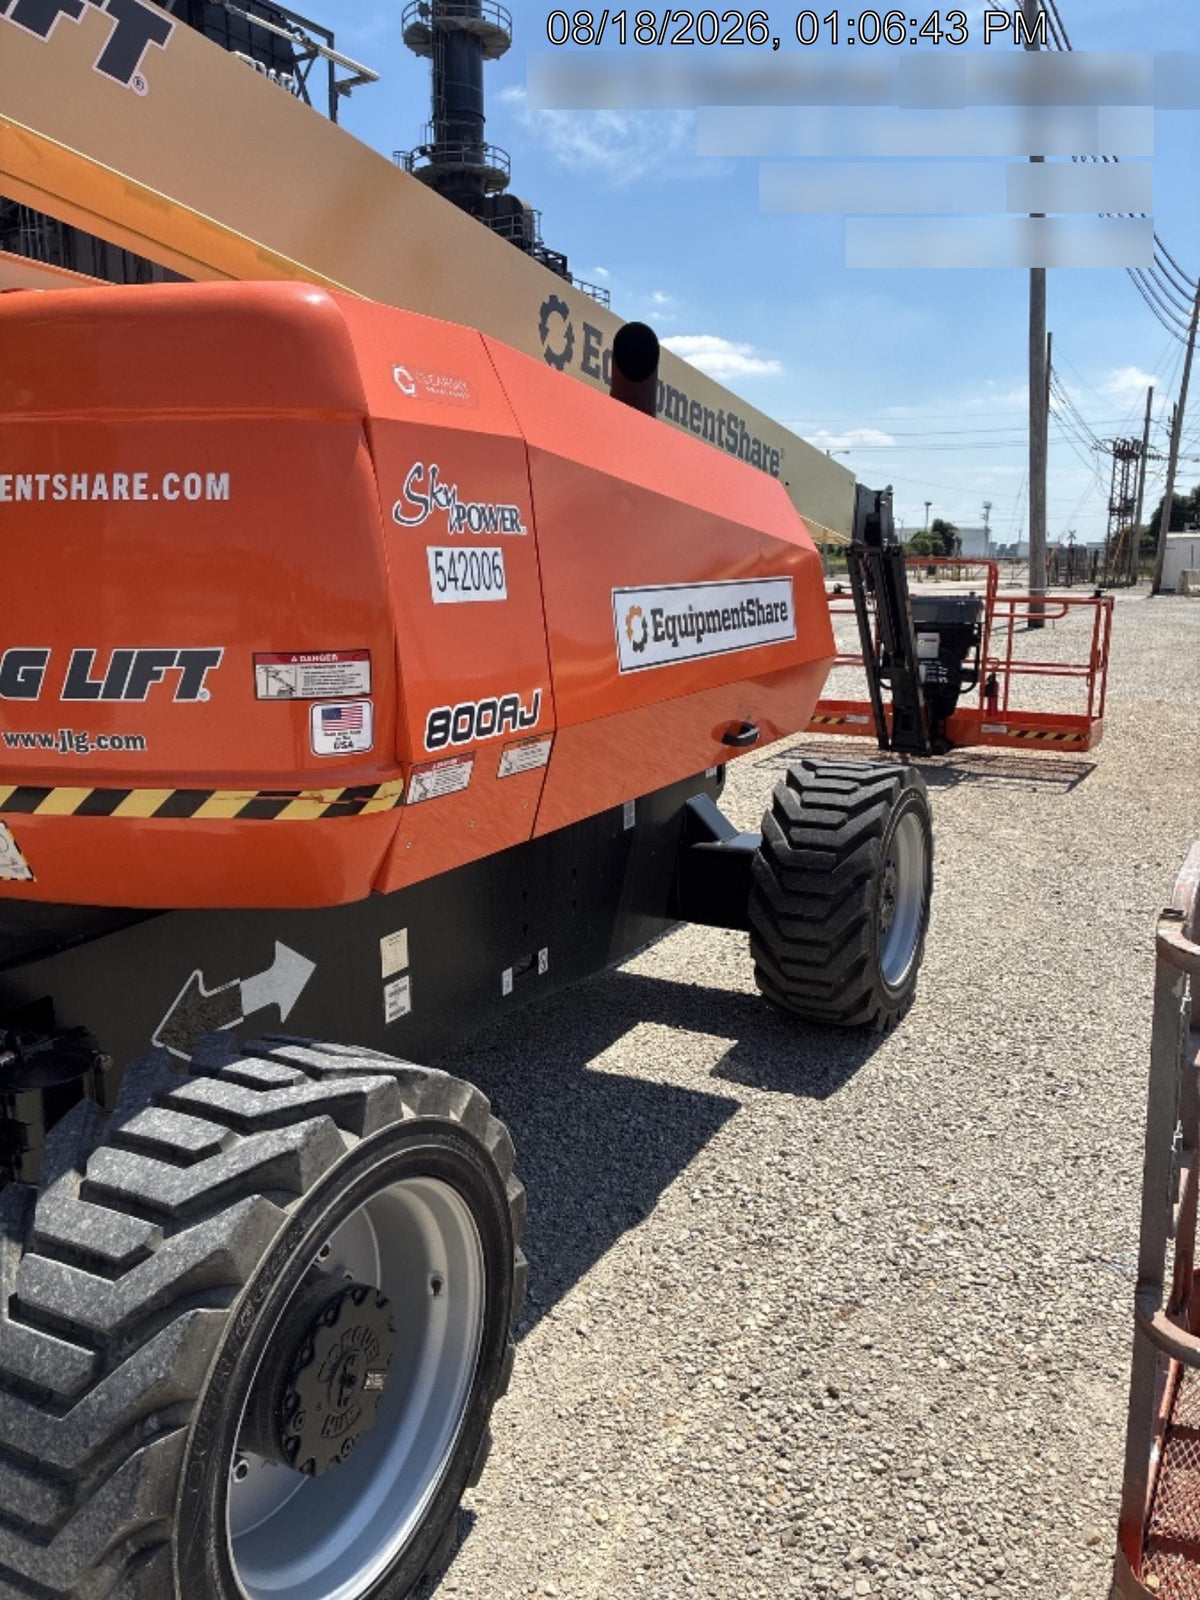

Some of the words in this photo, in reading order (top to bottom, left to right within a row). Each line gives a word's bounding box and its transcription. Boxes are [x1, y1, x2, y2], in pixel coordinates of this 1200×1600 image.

[580, 321, 781, 478] EmentShare
[434, 551, 504, 592] 542006
[650, 597, 789, 648] EquipmentShare
[60, 647, 225, 702] LIFT
[299, 653, 339, 663] DANGER
[2, 728, 147, 754] www.jlg.com
[424, 688, 542, 752] 800AJ
[333, 740, 355, 751] USA
